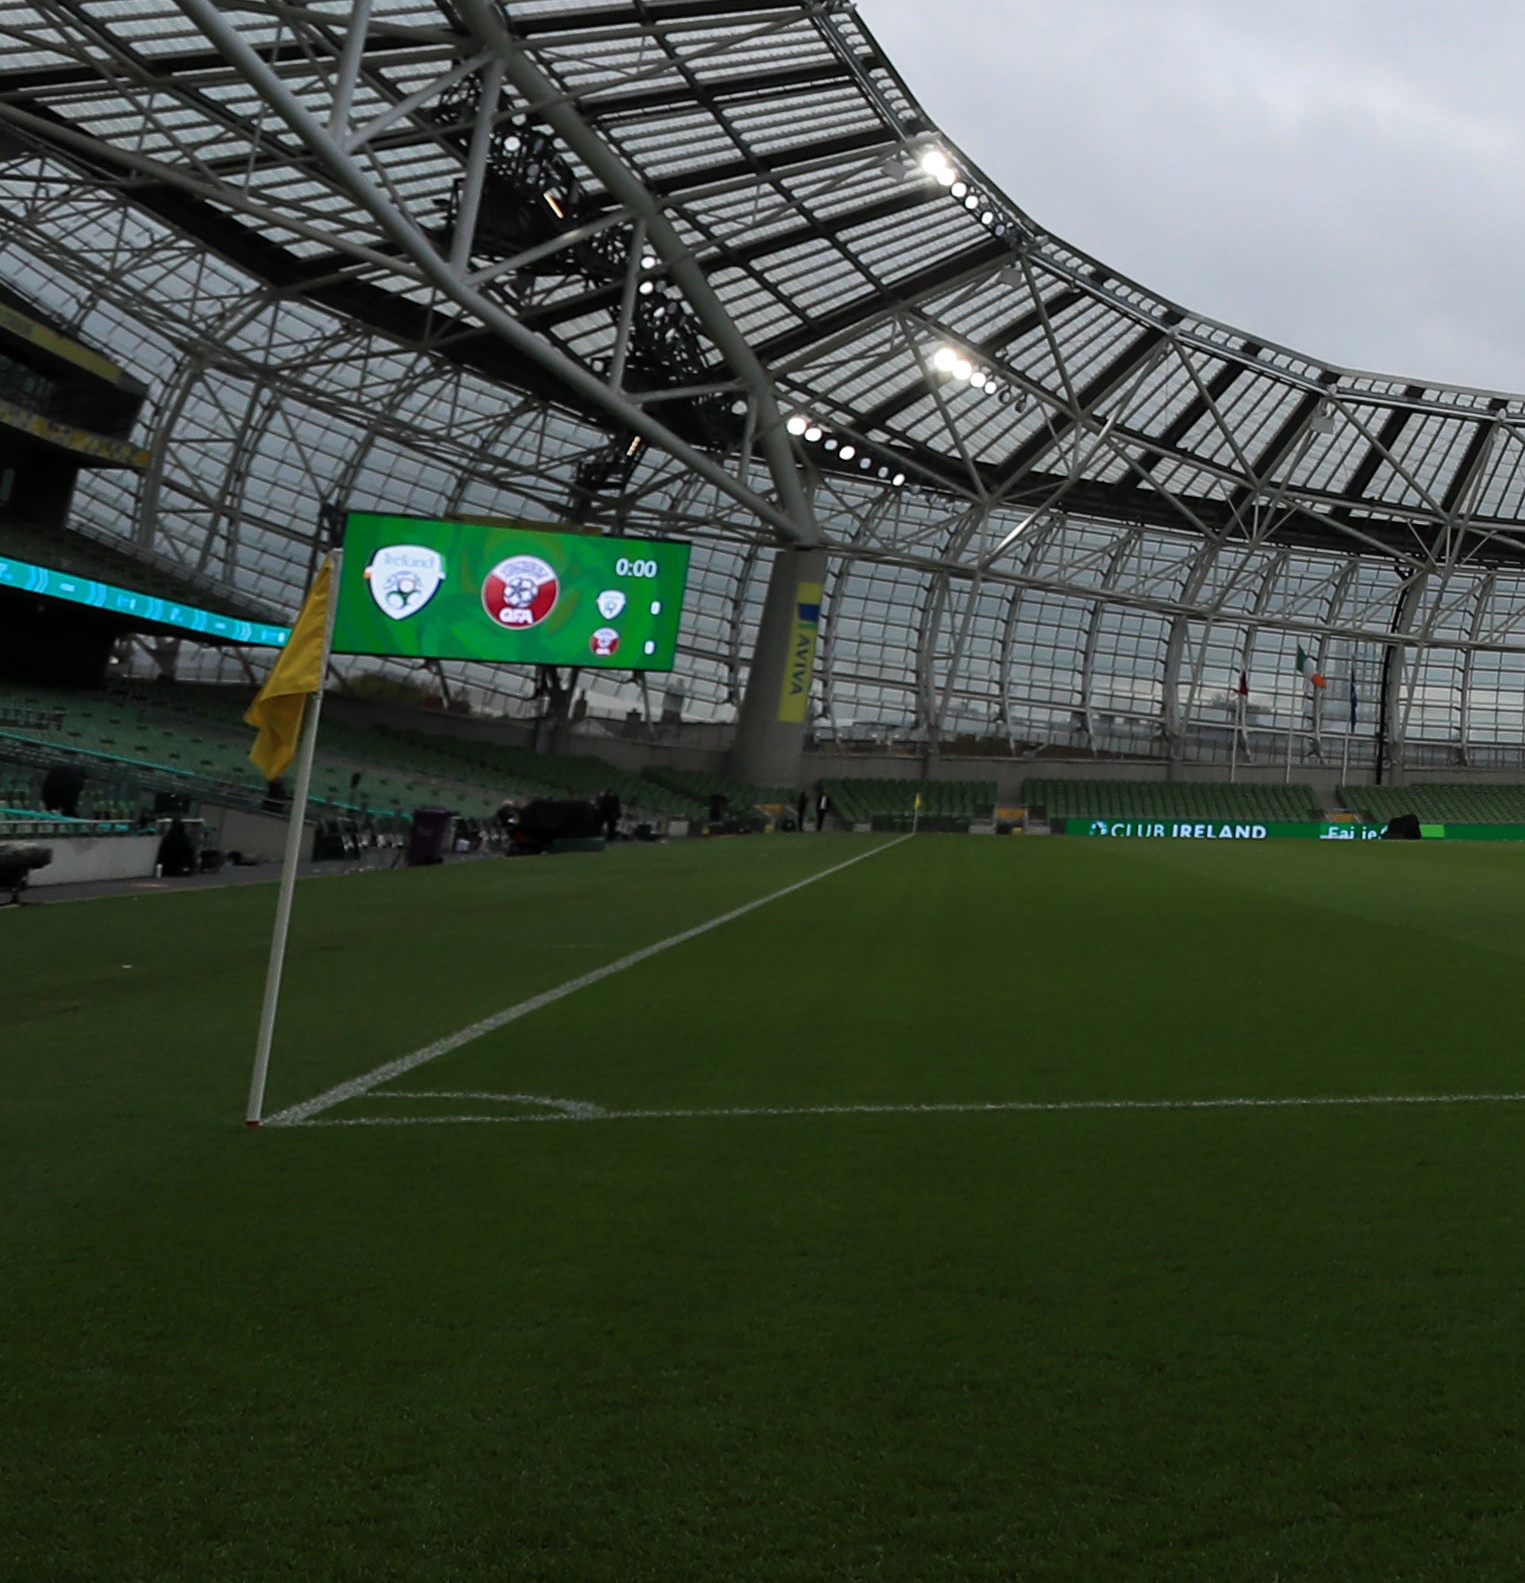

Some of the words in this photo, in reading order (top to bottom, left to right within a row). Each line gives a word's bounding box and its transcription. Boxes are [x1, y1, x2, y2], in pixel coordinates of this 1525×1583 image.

[615, 557, 657, 579] 0:00
[789, 634, 811, 695] AVIVA
[1110, 823, 1165, 838] CLUB
[1172, 824, 1267, 839] IRELAND
